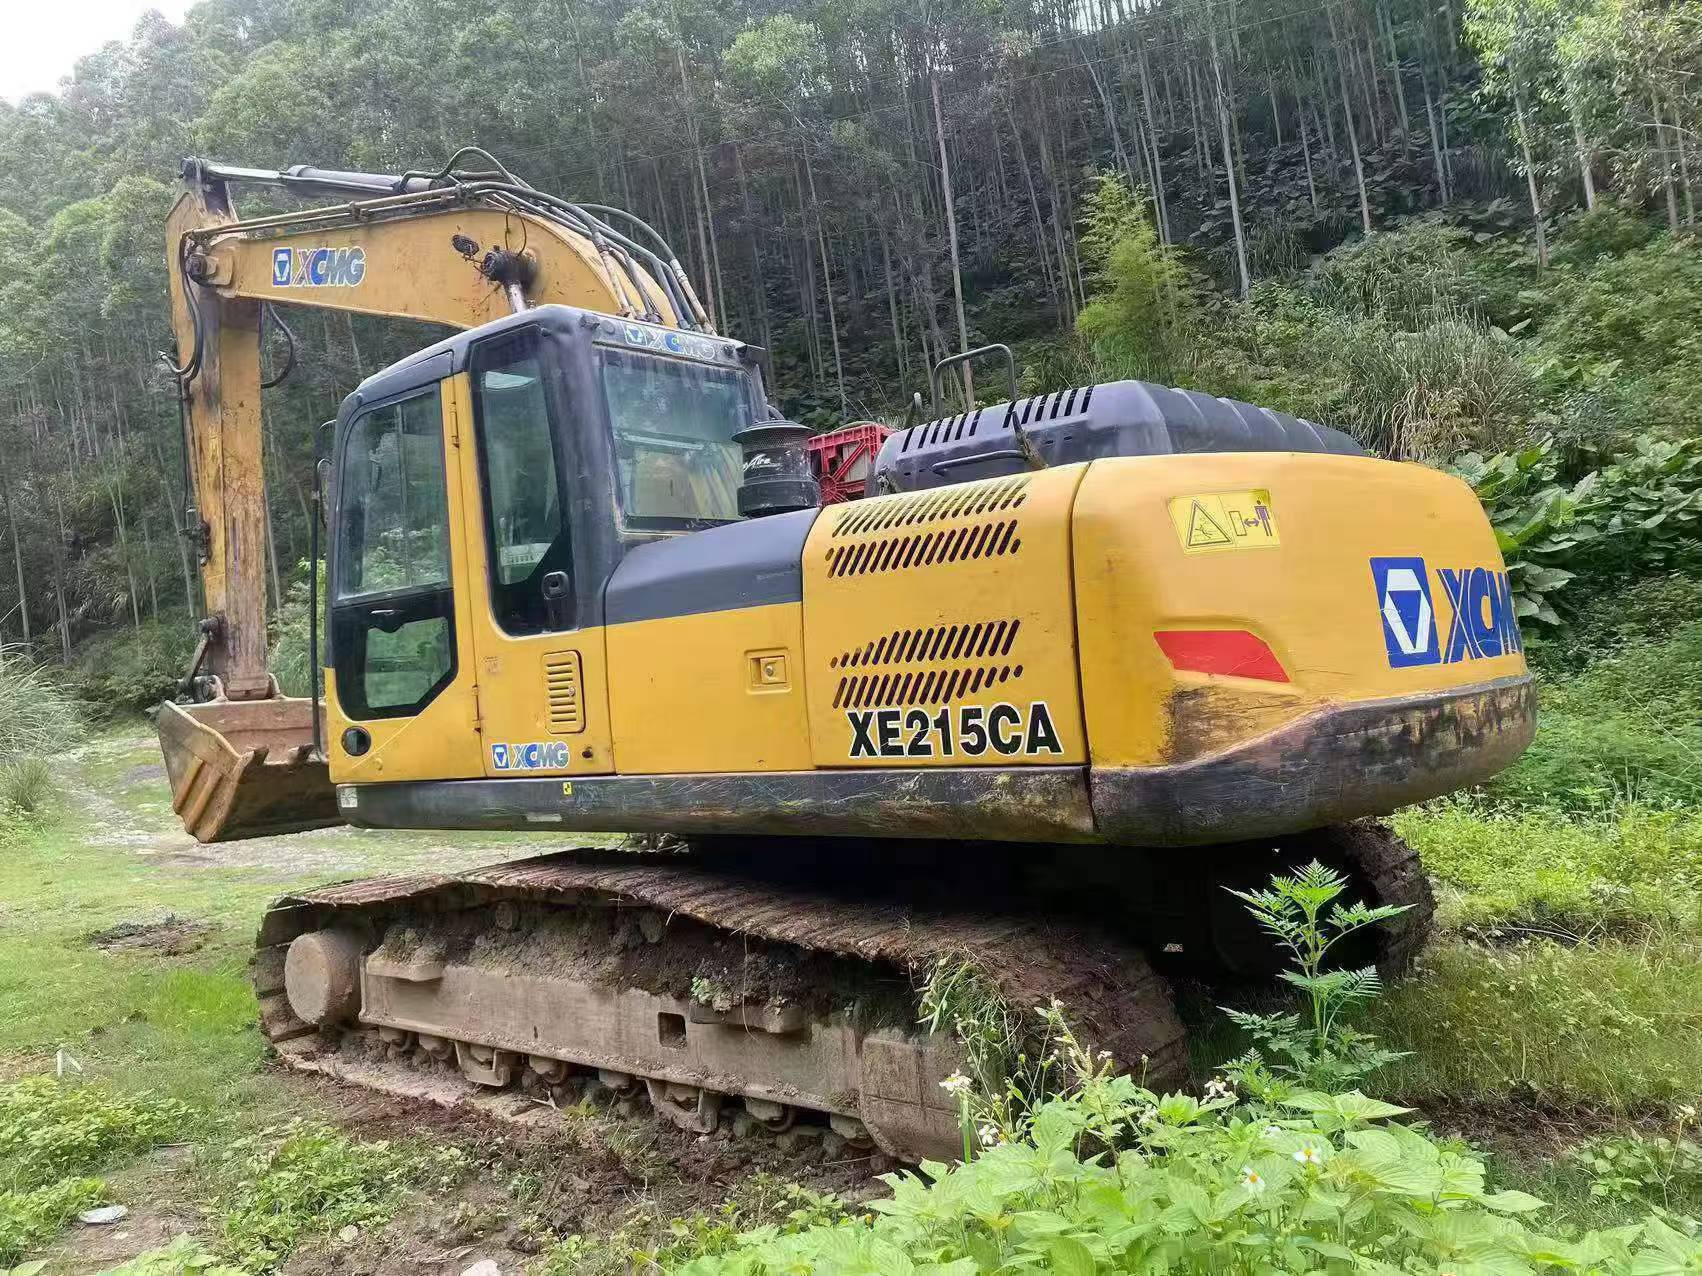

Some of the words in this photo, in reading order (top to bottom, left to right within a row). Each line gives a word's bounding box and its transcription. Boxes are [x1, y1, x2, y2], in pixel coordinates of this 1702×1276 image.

[292, 246, 366, 287] XCMG
[647, 326, 716, 360] XCMG
[846, 701, 1064, 758] XE215CA
[511, 741, 570, 769] XCMG
